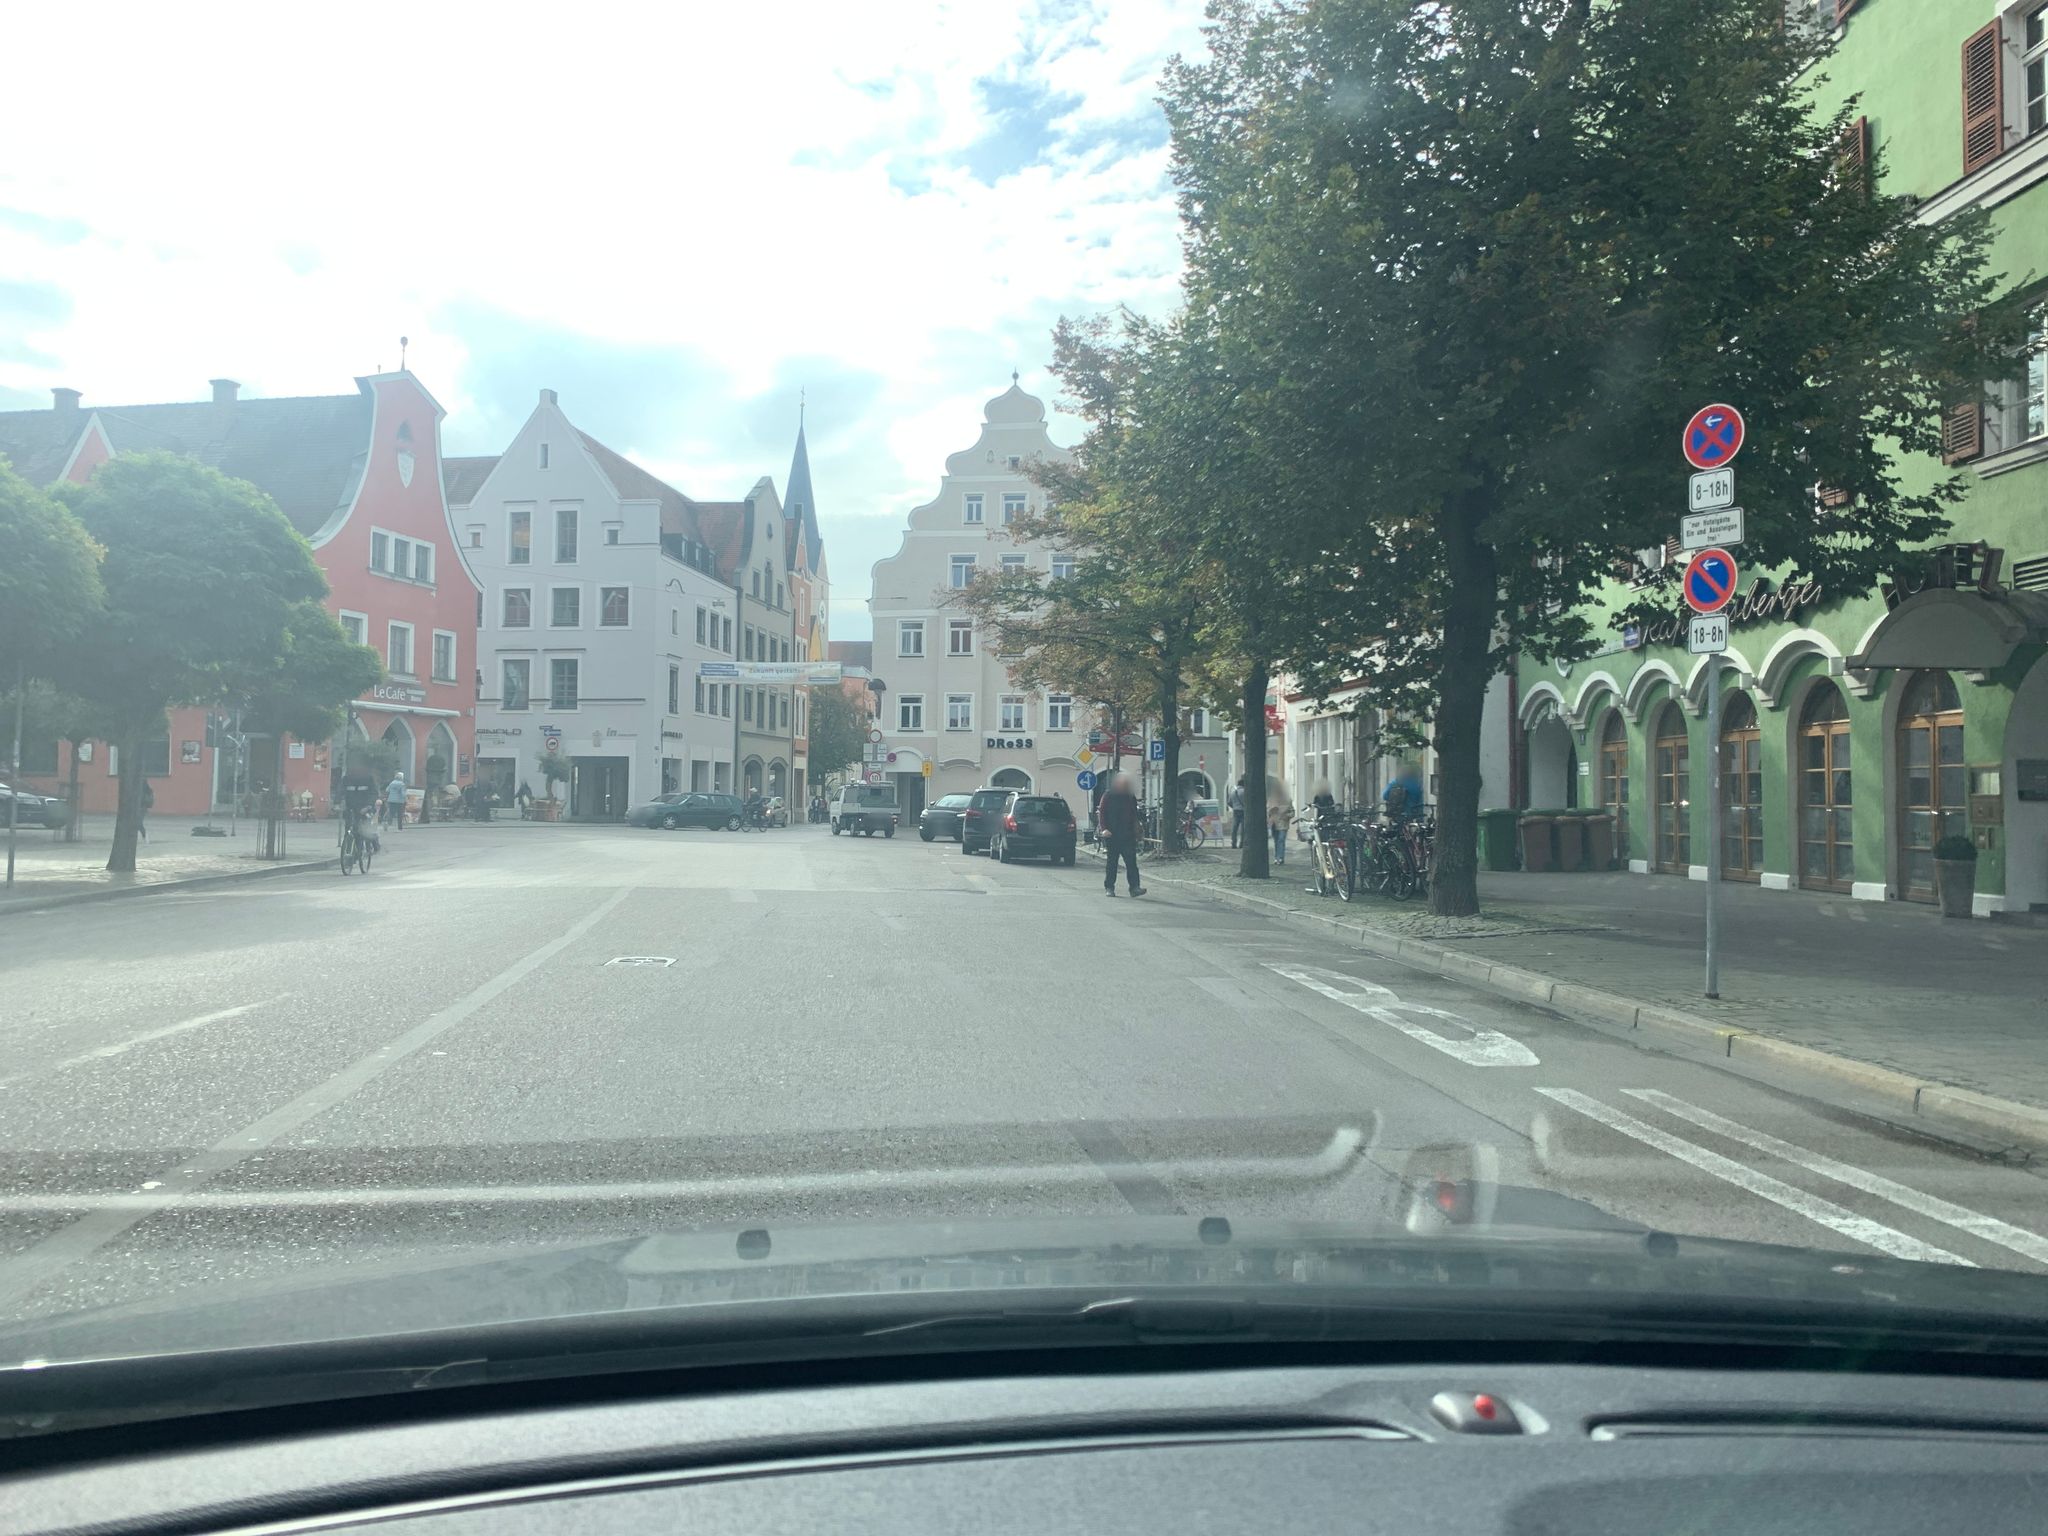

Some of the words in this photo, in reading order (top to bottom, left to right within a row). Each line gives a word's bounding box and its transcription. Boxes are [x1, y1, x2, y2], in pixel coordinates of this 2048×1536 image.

[1695, 479, 1729, 501] 8-18h
[1693, 625, 1724, 644] 18-8h
[373, 684, 385, 698] Le
[1153, 743, 1162, 758] P
